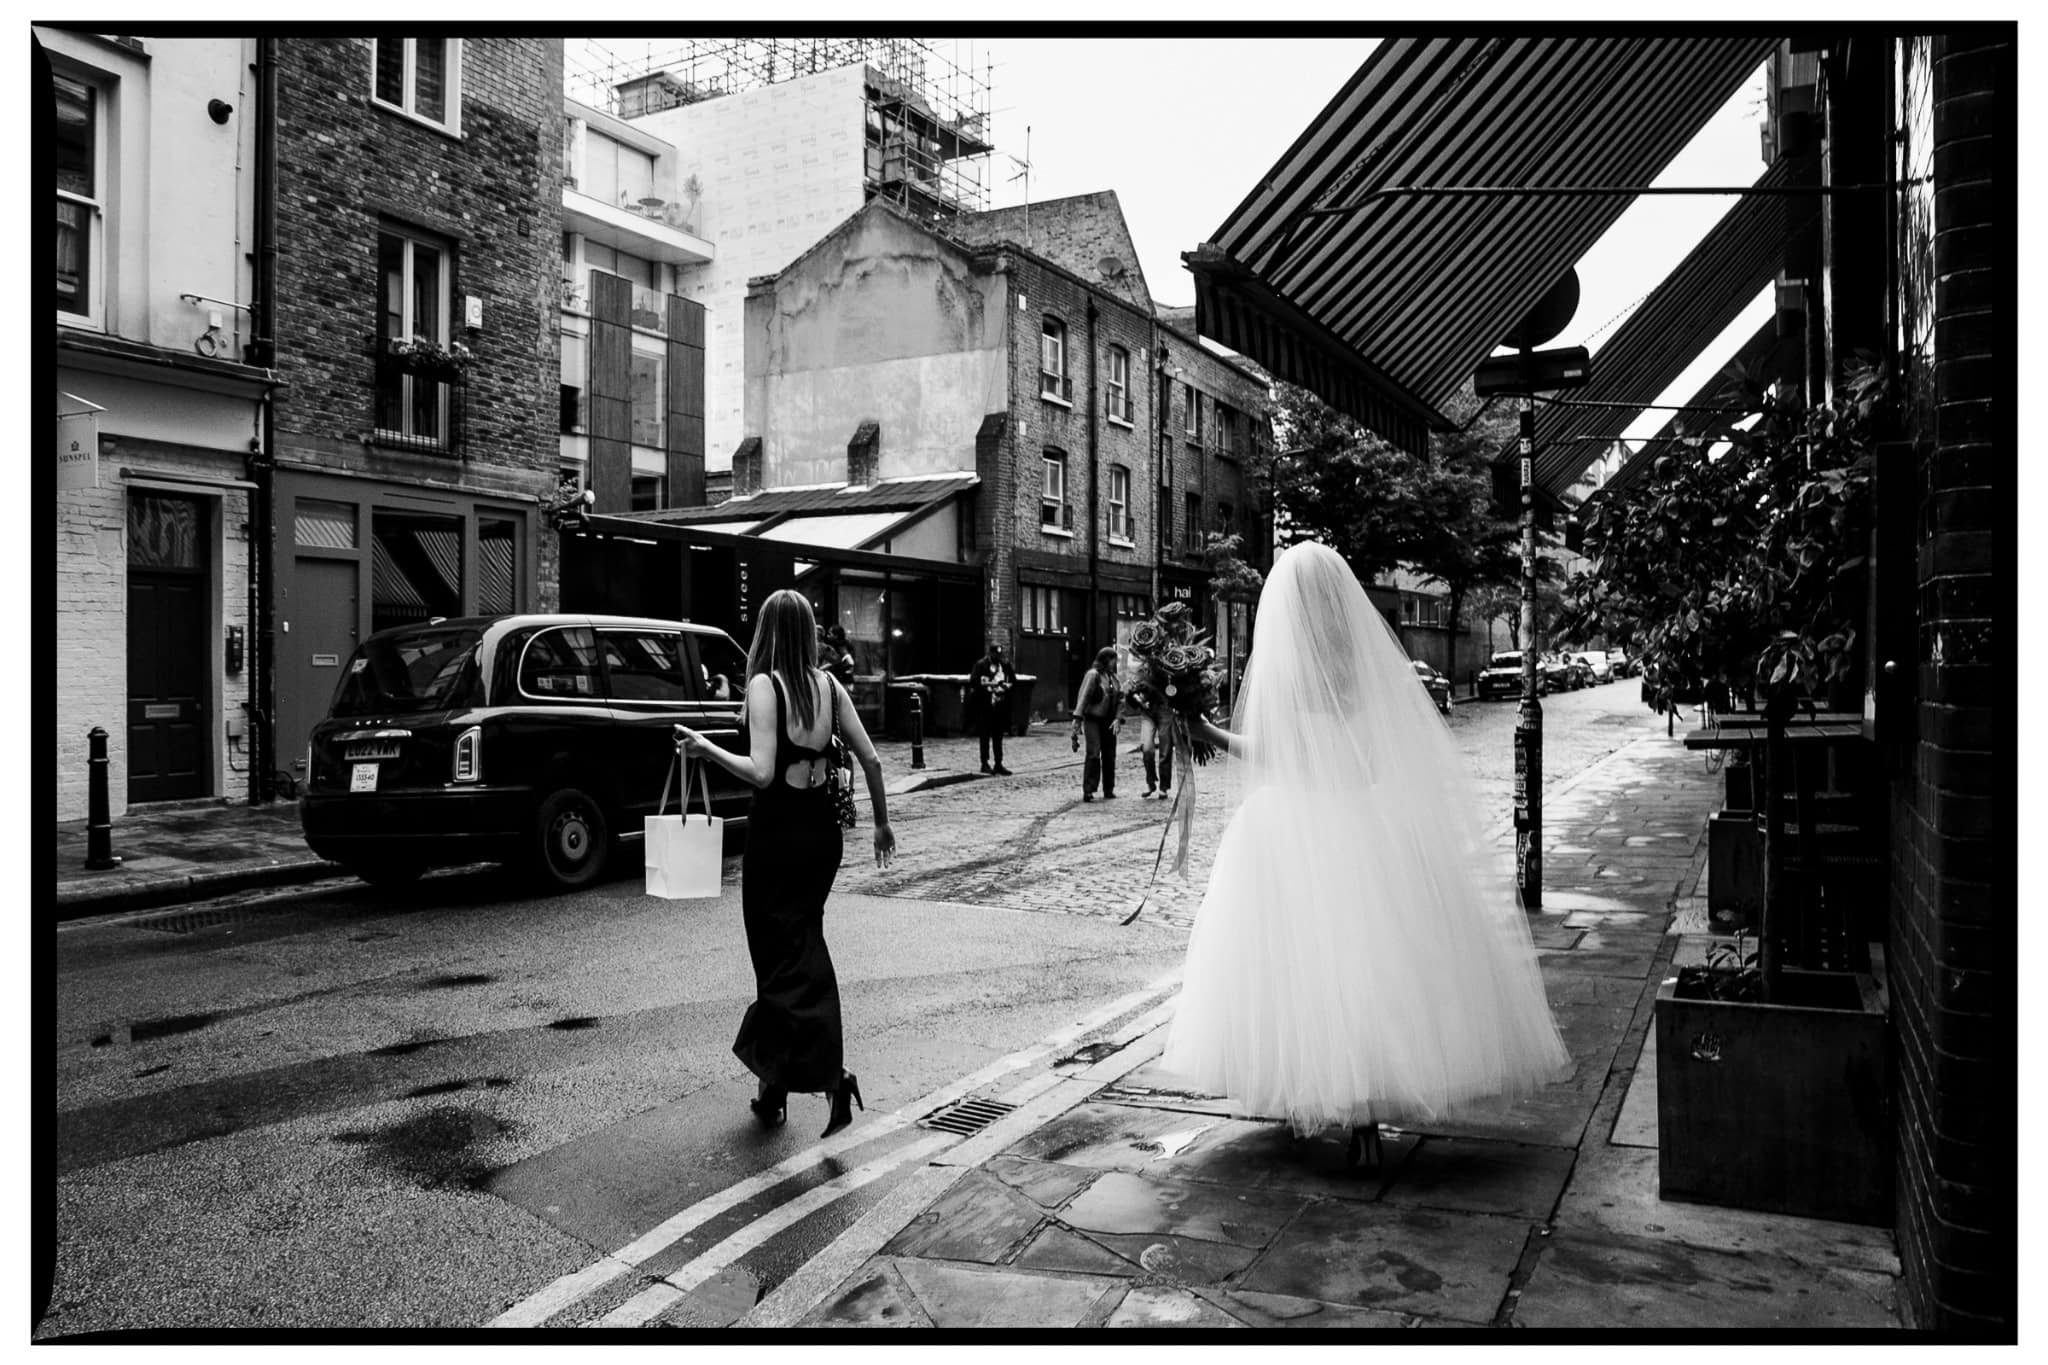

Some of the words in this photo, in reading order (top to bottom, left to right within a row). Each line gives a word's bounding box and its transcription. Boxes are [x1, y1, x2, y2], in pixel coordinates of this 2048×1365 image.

[58, 452, 90, 464] SUNSPEL
[739, 562, 748, 622] street
[1174, 585, 1191, 598] hai
